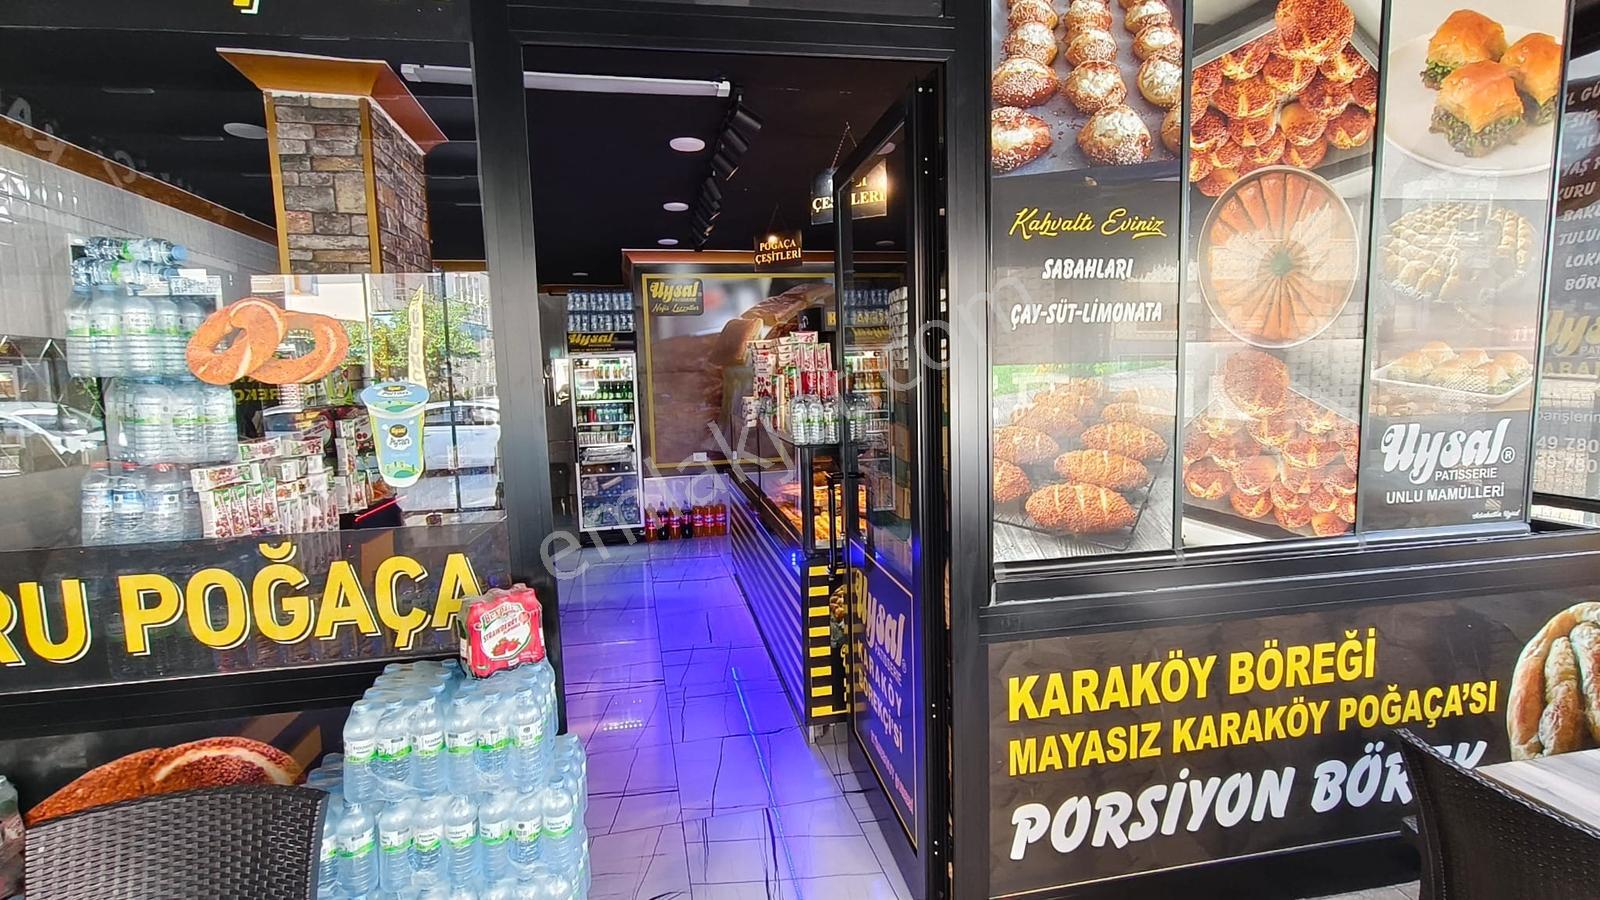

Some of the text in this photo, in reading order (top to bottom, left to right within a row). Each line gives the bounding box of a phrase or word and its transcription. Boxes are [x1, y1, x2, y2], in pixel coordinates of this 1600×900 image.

[1009, 208, 1168, 240] Kahvaltı Eviniz
[755, 247, 801, 265] ÇEŞİTLERİ
[1041, 258, 1135, 281] SABAHLARI
[650, 281, 699, 303] Uysal
[1010, 298, 1163, 330] ÇAY-SÜT-LİMONATA
[568, 333, 615, 347] Uysal
[1381, 418, 1512, 484] Uysal
[1435, 468, 1498, 481] PATISSERIE
[1386, 482, 1504, 504] UNLU MAMÜLLERİ
[118, 541, 484, 656] POĞAÇA
[855, 569, 905, 668] Uysal
[857, 639, 903, 717] KARAKÖY
[1008, 627, 1376, 722] KARAKÖY BÖREĞİ
[1009, 720, 1161, 777] MAYASIZ
[1172, 697, 1325, 754] KARAKÖY
[1010, 766, 1295, 861] PORSİYON
[1312, 740, 1488, 815] BÖRK
